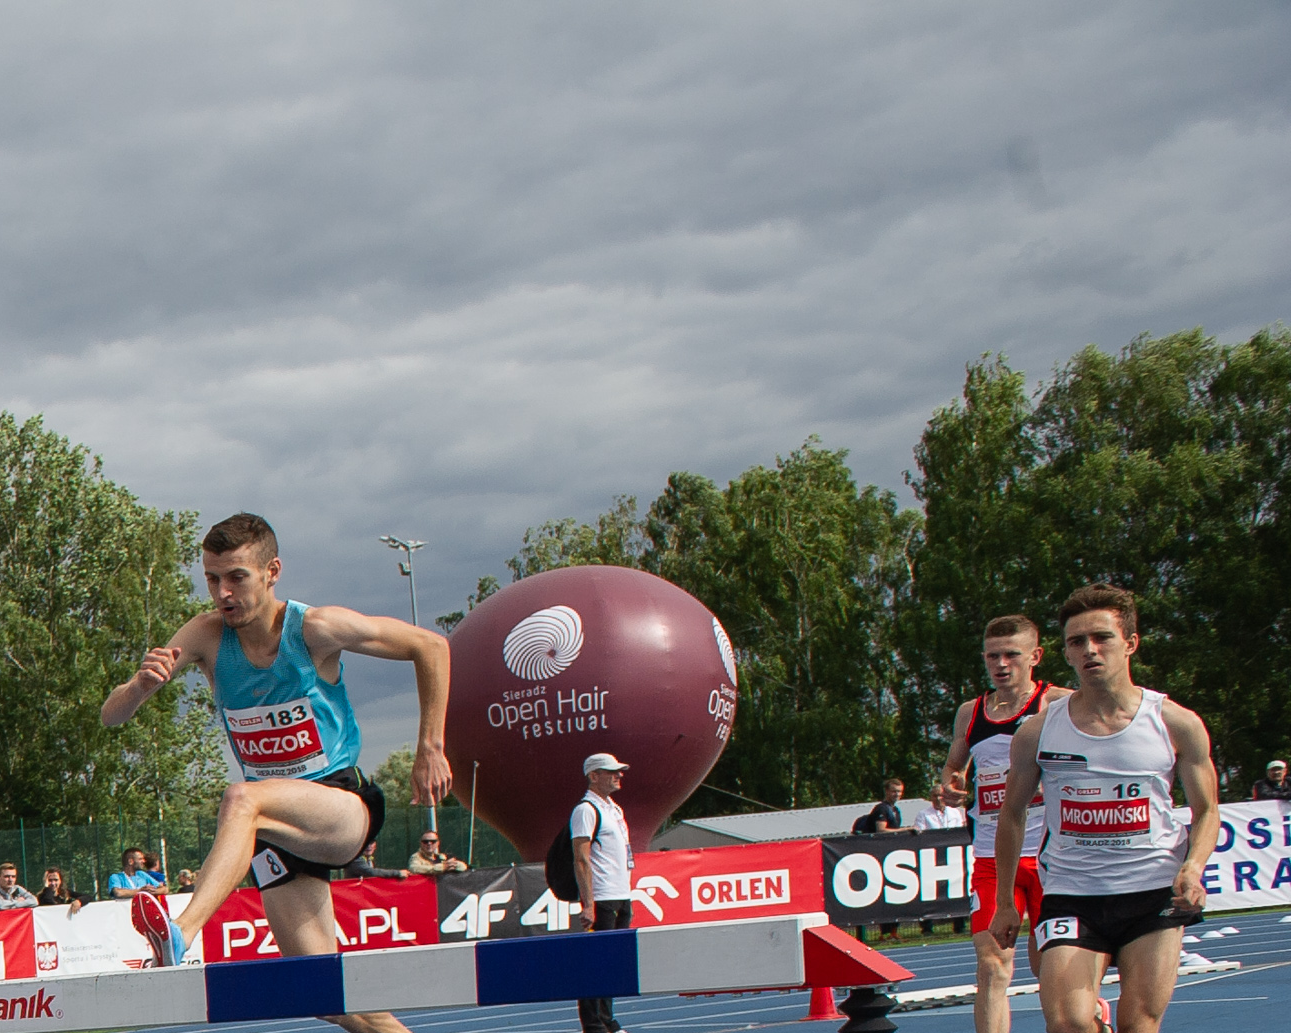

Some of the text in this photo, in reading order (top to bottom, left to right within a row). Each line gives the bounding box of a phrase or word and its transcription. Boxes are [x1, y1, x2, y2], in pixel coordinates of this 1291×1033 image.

[502, 685, 547, 702] Sieradz
[265, 705, 308, 728] 183
[487, 686, 610, 730] Open Hair
[236, 729, 314, 756] KACZOR
[286, 764, 308, 776] 2018
[982, 789, 1006, 806] DĘB
[1113, 783, 1141, 799] 16
[1062, 804, 1148, 826] MROWIŃSKI
[266, 853, 282, 876] 8
[697, 875, 784, 905] ORLEN
[439, 889, 513, 939] 4F
[222, 906, 417, 958] PZ.PL
[1039, 919, 1071, 940] 15
